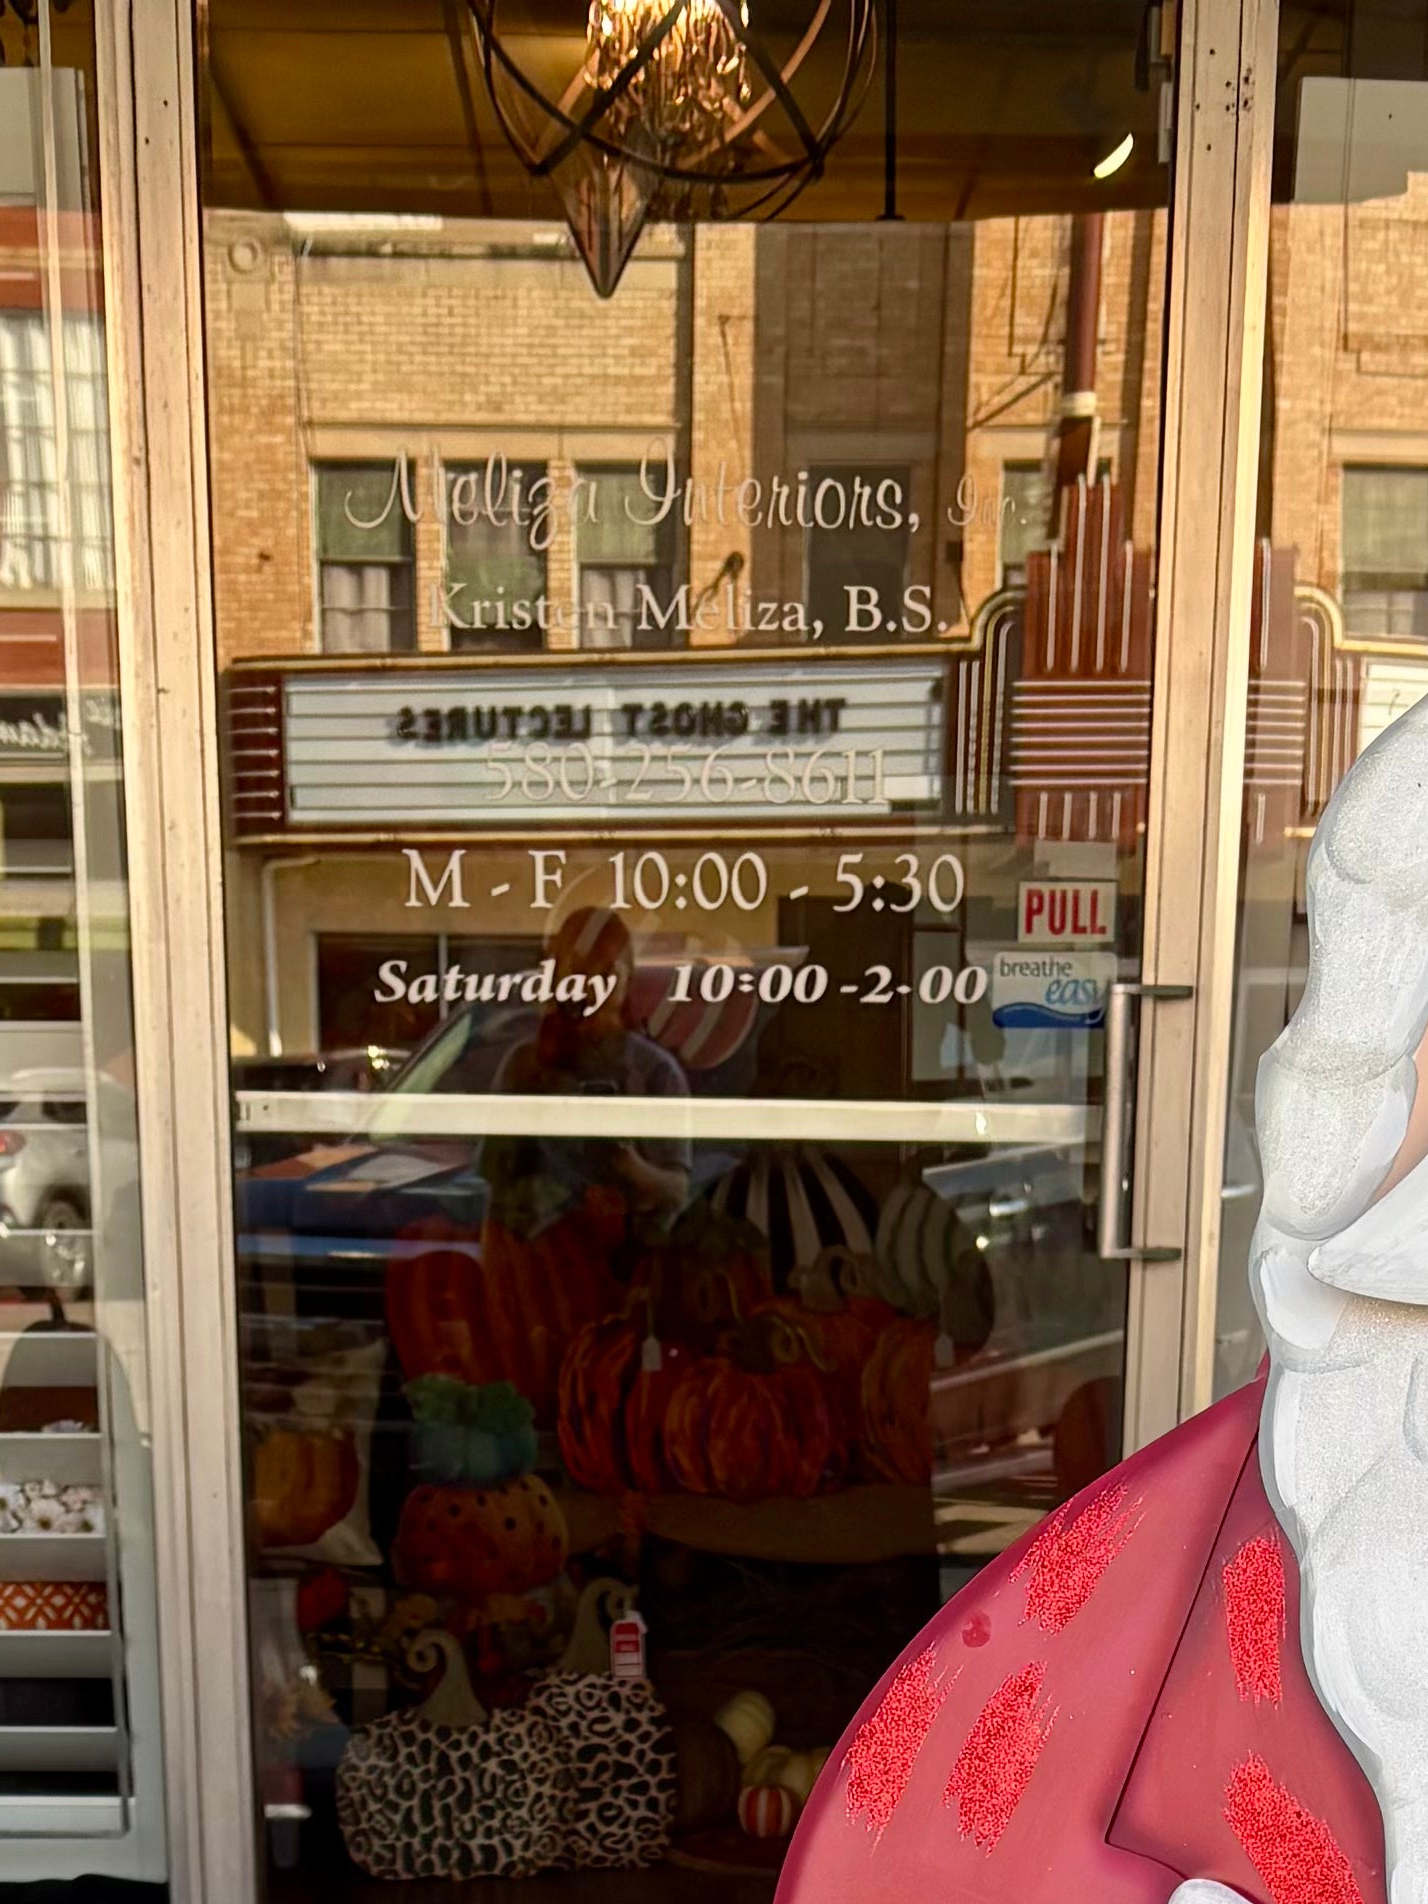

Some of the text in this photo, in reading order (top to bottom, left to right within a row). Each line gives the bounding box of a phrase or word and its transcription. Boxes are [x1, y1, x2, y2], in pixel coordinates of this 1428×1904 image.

[344, 445, 599, 550] Meliza
[624, 437, 920, 532] Interiors,
[429, 582, 948, 639] Kristen Meliza, B.S.
[485, 741, 888, 805] 580-256-8611
[401, 849, 472, 908] M
[529, 849, 568, 909] F
[609, 850, 769, 911] 10:00
[832, 852, 966, 912] 5:30
[1025, 888, 1107, 935] PULL
[374, 958, 617, 1017] Saturday
[668, 963, 829, 1003] 10:00
[999, 957, 1074, 978] breathe
